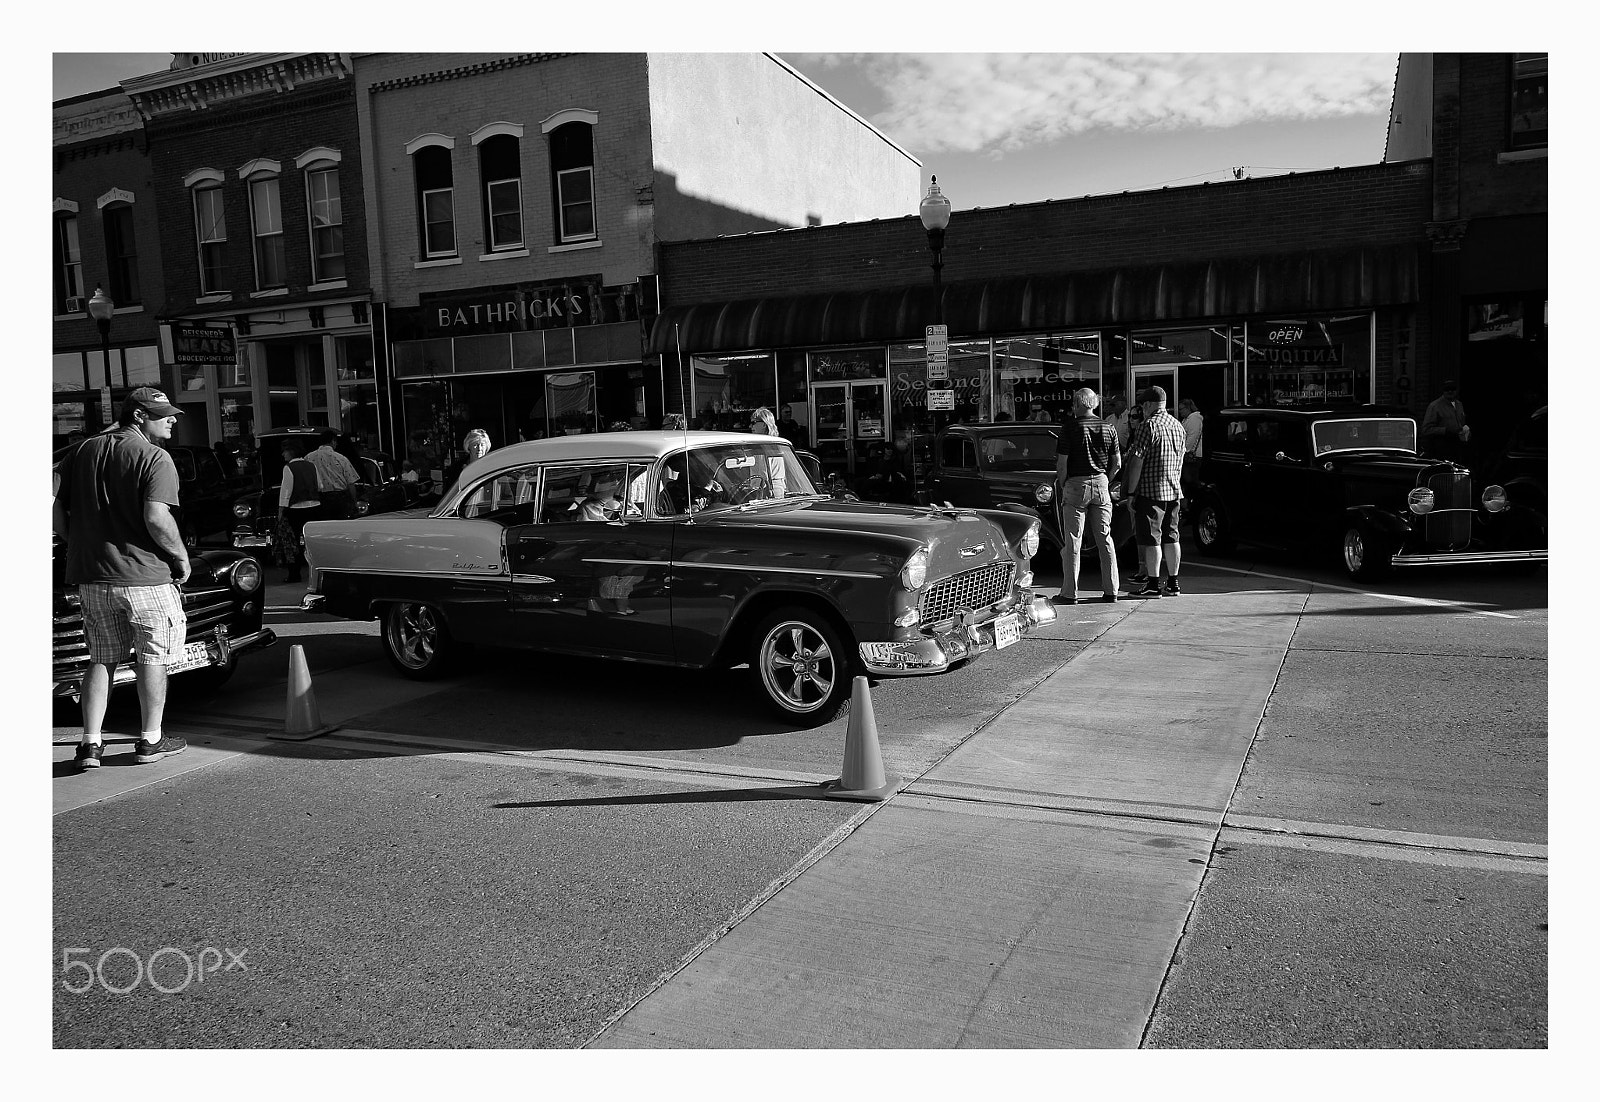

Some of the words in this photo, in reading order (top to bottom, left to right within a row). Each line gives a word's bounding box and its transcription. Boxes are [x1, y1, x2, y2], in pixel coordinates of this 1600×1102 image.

[438, 295, 583, 326] BATHRICK'S
[1268, 330, 1303, 341] OPEN
[177, 338, 232, 354] MEATS
